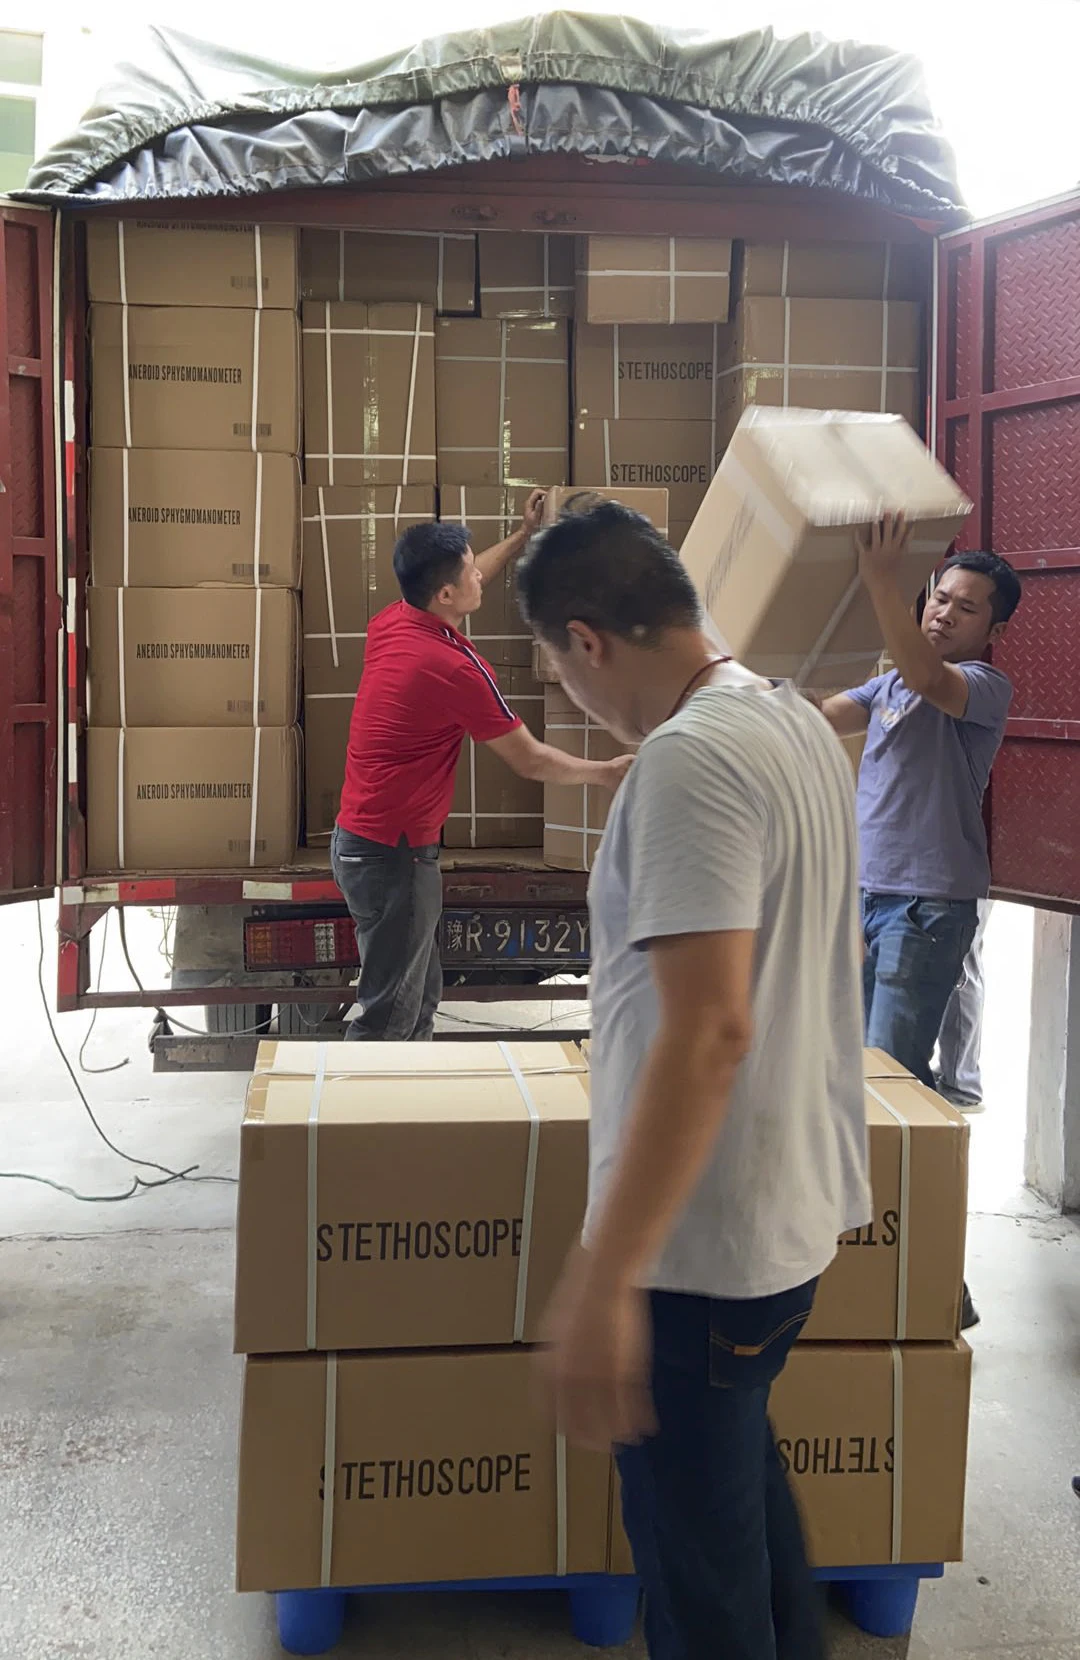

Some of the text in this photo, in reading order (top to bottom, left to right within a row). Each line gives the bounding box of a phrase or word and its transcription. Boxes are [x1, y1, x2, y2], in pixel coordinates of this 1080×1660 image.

[128, 364, 242, 384] ANEROID SPHYGMOMANOMETER
[618, 361, 713, 380] STETHOSCOPE
[610, 463, 706, 483] STETHOSCOPE
[128, 507, 241, 525] ANEROID SPHYGMOMANOMETER
[136, 643, 250, 659] ANEROID SPHYGMOMANOMETER
[137, 783, 252, 800] ANEROID SPHYGMOMANOMETER
[837, 1210, 899, 1246] ST
[316, 1218, 523, 1261] STETHOSCOPE
